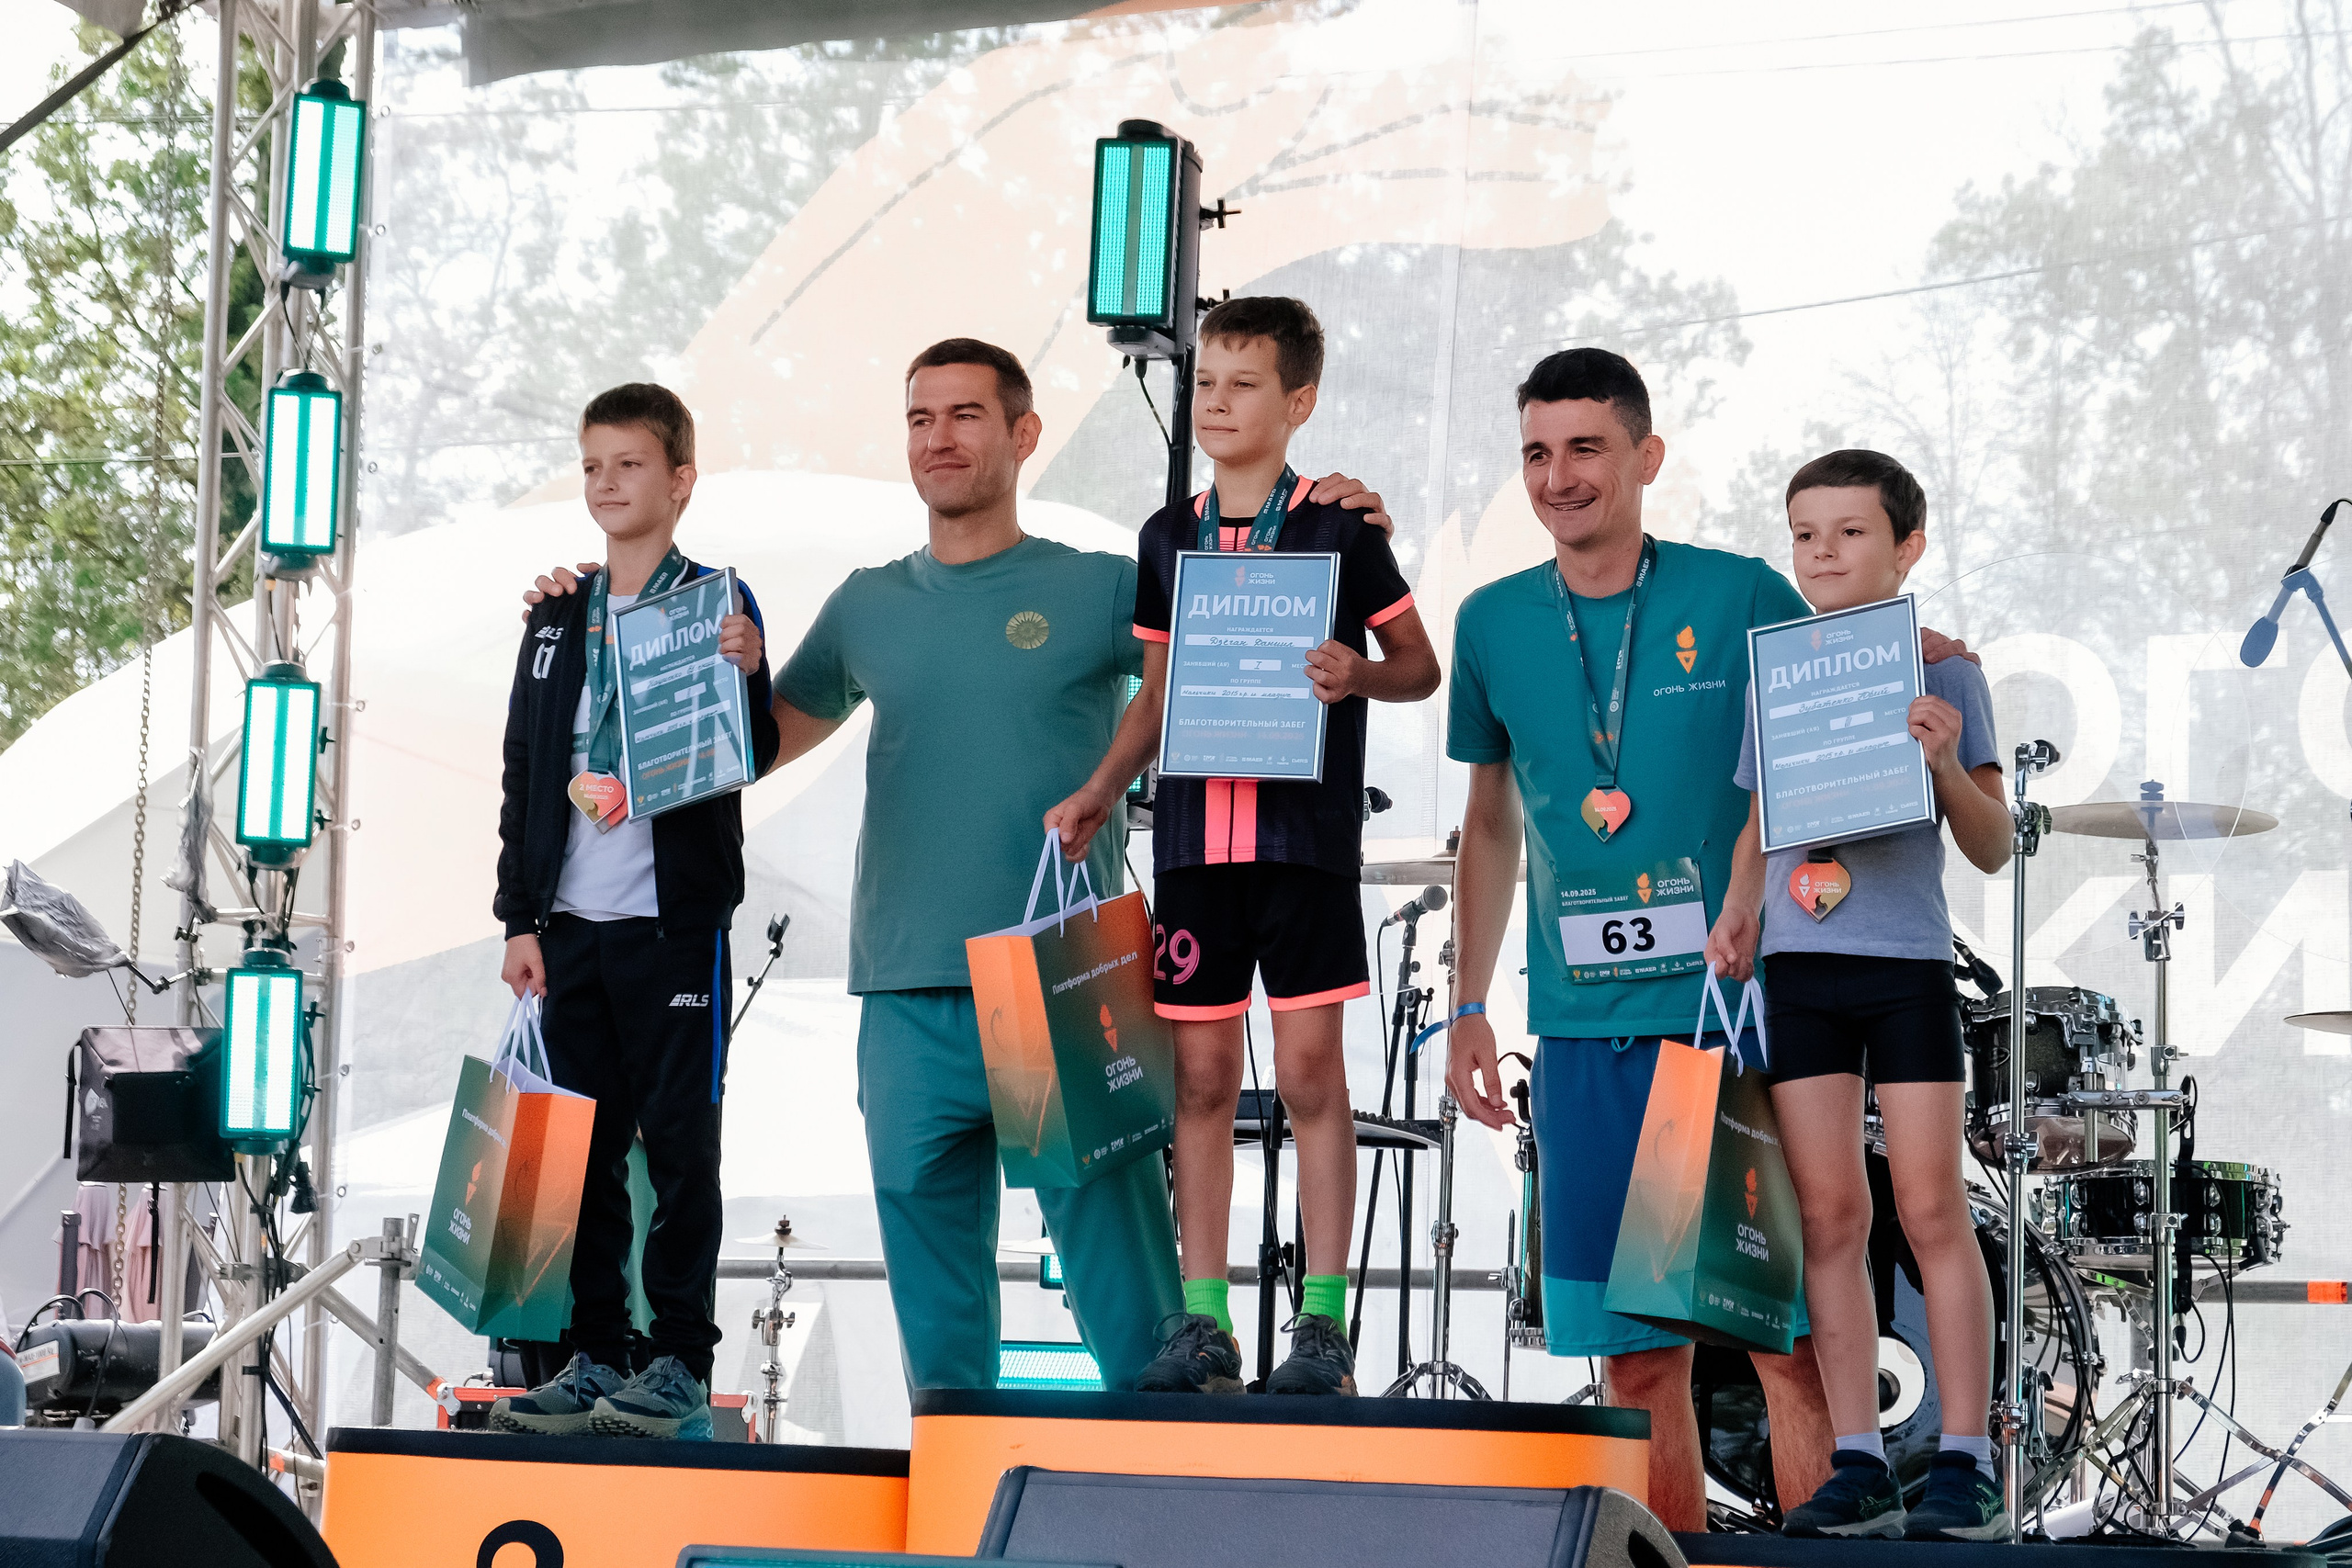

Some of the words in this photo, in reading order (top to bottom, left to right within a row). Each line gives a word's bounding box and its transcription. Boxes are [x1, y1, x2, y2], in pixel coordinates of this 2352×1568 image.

[1638, 558, 1651, 582] MAER
[1187, 594, 1317, 619] ДИПЛОМ
[629, 614, 723, 671] ДИПЛОМ
[1825, 635, 1854, 646] ЖИЗНИ
[1826, 629, 1851, 639] ОГОНЬ
[1182, 660, 1215, 669] ЗАНЯВШИЙ
[1768, 641, 1901, 694] ДИПЛОМ
[1654, 684, 1685, 696] ОГОНЬ
[1689, 680, 1726, 692] ЖИЗНИ
[1811, 682, 1860, 697] НАГРАЖДАЕТСЯ
[1179, 718, 1278, 728] БЛАГОТВОРИТЕЛЬНЫЙ
[1280, 720, 1306, 728] ЗАБЕГ
[1884, 707, 1906, 716] МЕСТО
[1833, 735, 1856, 744] ГРУППЕ
[586, 784, 615, 793] МЕСТО
[1776, 769, 1881, 800] БЛАГОТВОРИТЕЛЬНЫЙ
[1883, 764, 1910, 778] ЗАБЕГ
[1561, 889, 1597, 898] 14.09.2025
[1656, 885, 1694, 897] ЖИЗНИ
[1657, 877, 1690, 887] ОГОНЬ
[1601, 917, 1656, 955] 63
[1153, 923, 1200, 986] 29
[1052, 971, 1091, 996] Платформа
[1091, 958, 1120, 979] добрых
[1120, 951, 1138, 967] дел
[1105, 1055, 1136, 1078] ОГОНЬ
[1107, 1066, 1144, 1094] ЖИЗНИ
[1751, 1128, 1779, 1147] добрых
[453, 1207, 472, 1230] ОГОНЬ
[447, 1220, 471, 1246] ЖИЗНИ
[1737, 1223, 1767, 1247] ОГОНЬ
[1736, 1237, 1770, 1263] ЖИЗНИ
